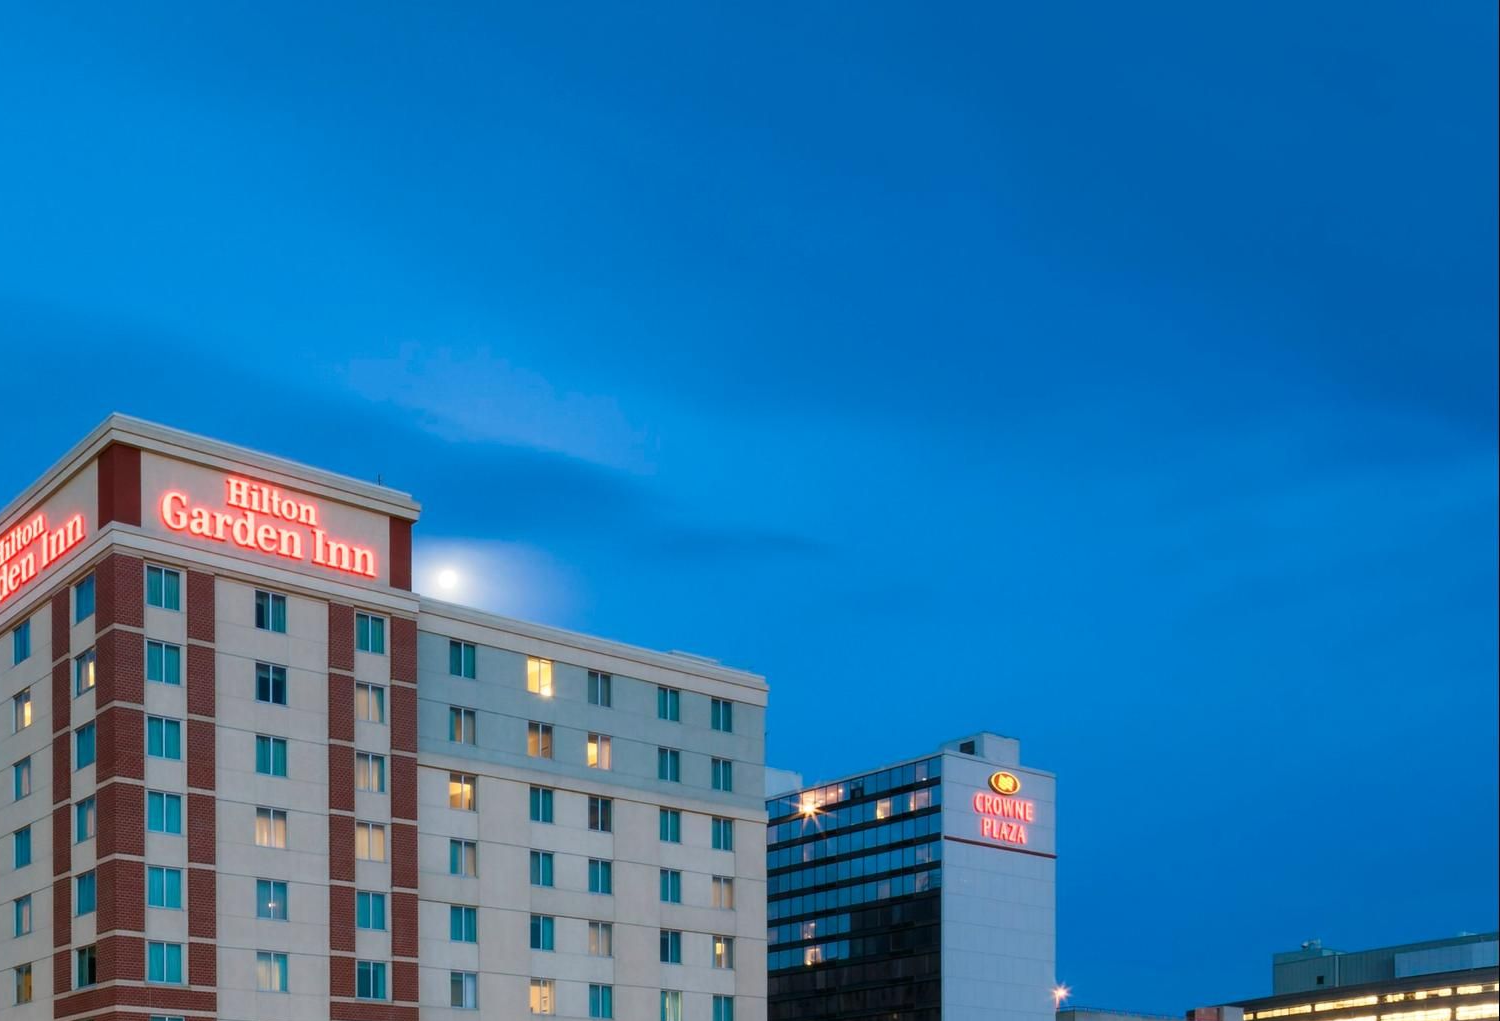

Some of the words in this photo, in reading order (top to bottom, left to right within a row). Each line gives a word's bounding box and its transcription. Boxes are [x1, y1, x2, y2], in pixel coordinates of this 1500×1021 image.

[226, 477, 319, 527] Hilton
[40, 513, 87, 571] Inn
[161, 491, 306, 561] Garden
[311, 527, 378, 578] Inn
[973, 791, 1034, 822] CROWNE
[981, 816, 1027, 845] PLAZA
